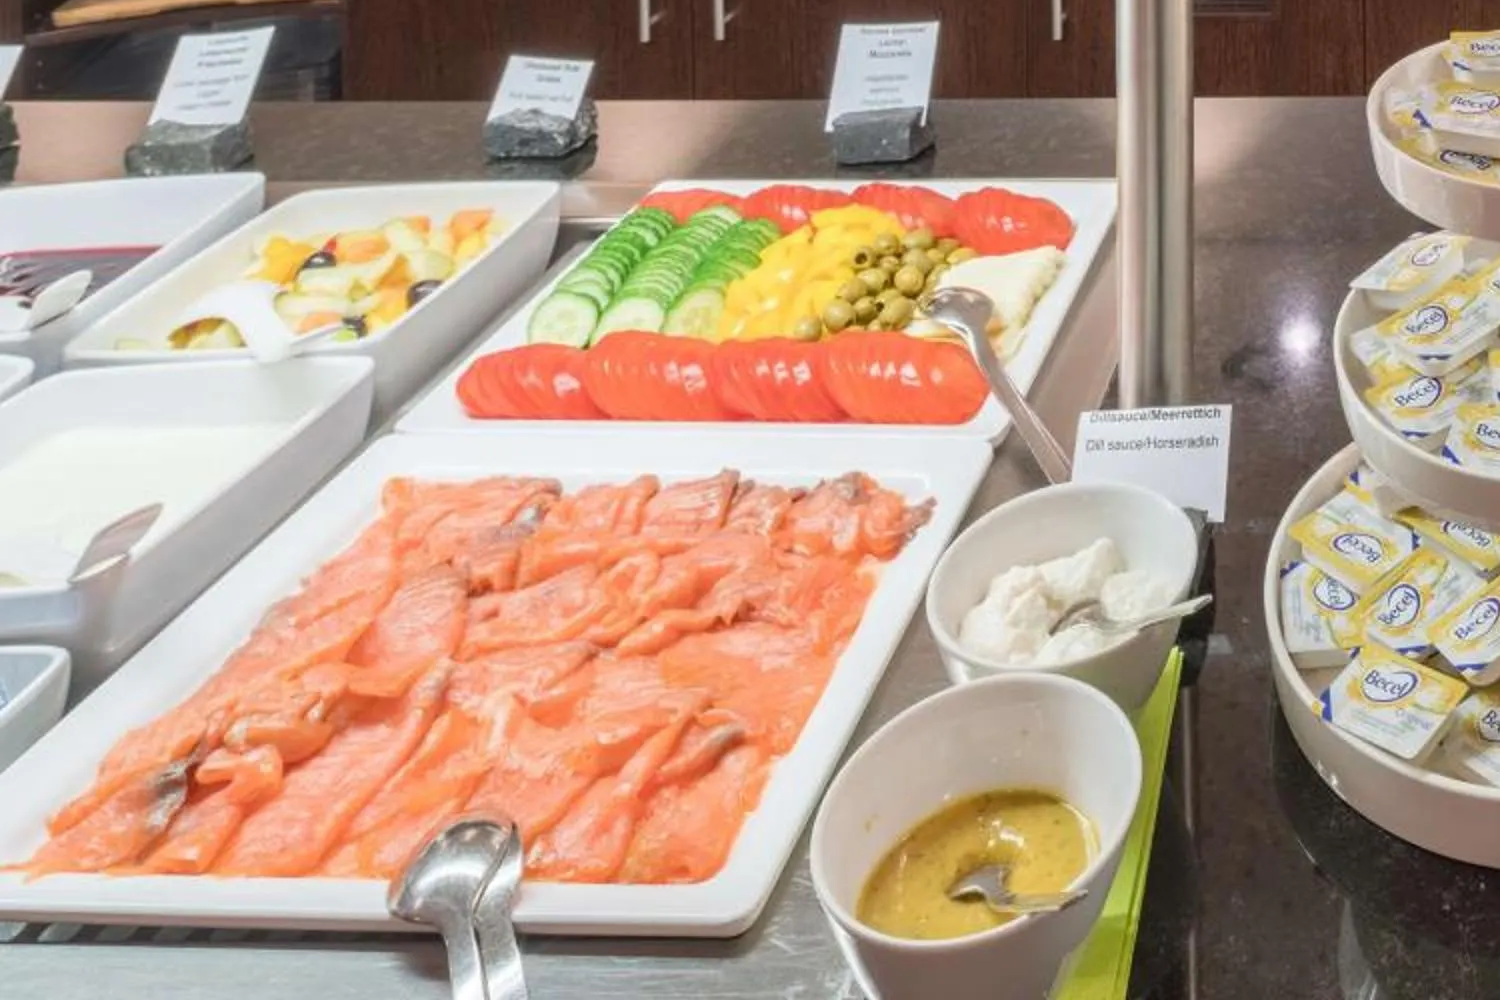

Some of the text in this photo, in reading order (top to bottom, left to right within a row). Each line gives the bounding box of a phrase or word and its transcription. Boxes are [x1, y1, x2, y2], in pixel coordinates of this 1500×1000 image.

[1394, 376, 1441, 408] Becel
[1341, 534, 1384, 563] Becel
[1377, 588, 1418, 625] Becel
[1454, 603, 1500, 640] Becel
[1364, 668, 1411, 695] Becel
